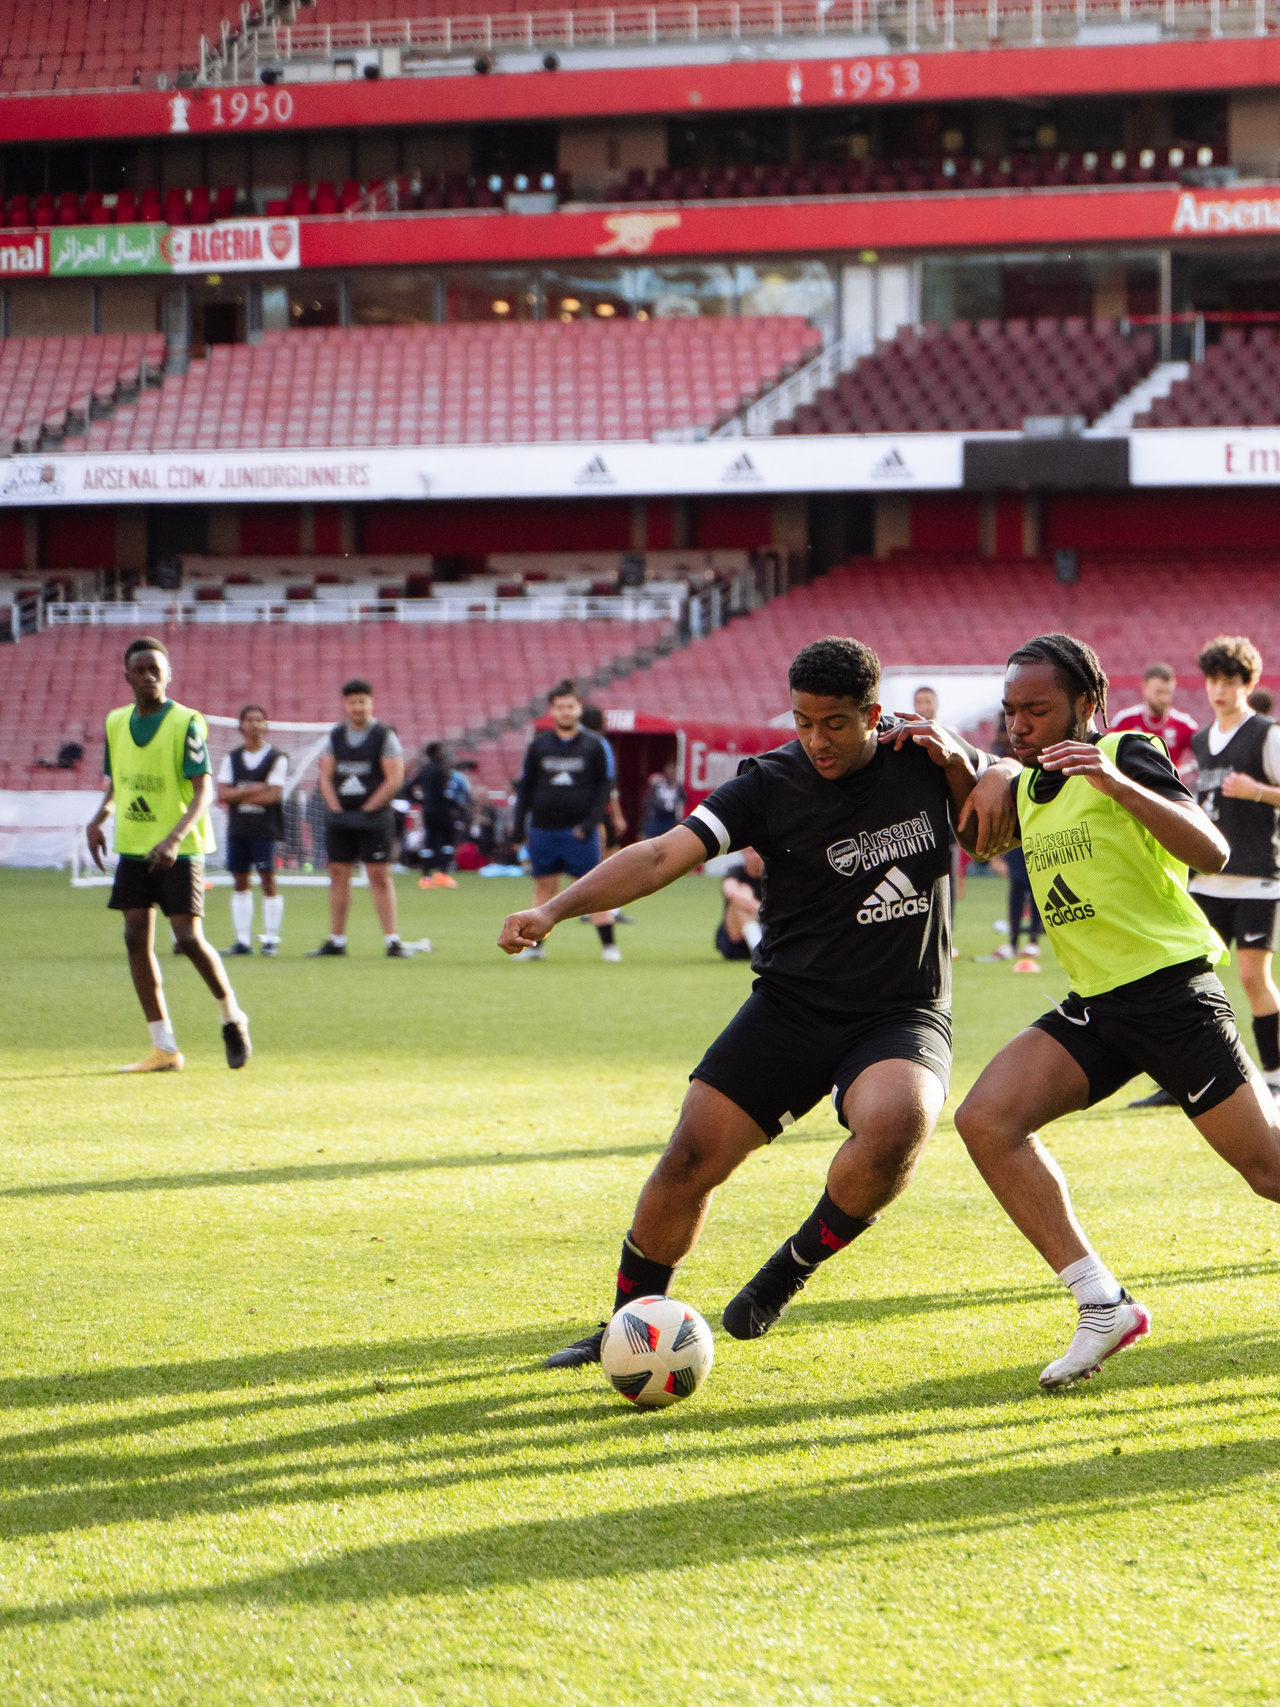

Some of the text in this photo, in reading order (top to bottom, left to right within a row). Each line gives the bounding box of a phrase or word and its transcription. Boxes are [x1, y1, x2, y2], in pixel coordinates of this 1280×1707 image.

[829, 59, 920, 99] 1953
[210, 90, 293, 125] 1950
[189, 229, 263, 263] ALGERIA
[859, 810, 933, 855] Arsenal
[1034, 821, 1091, 856] Arsenal
[861, 832, 936, 871] COMMUNITY
[1034, 843, 1093, 872] COMMUNITY
[856, 896, 929, 925] adidas
